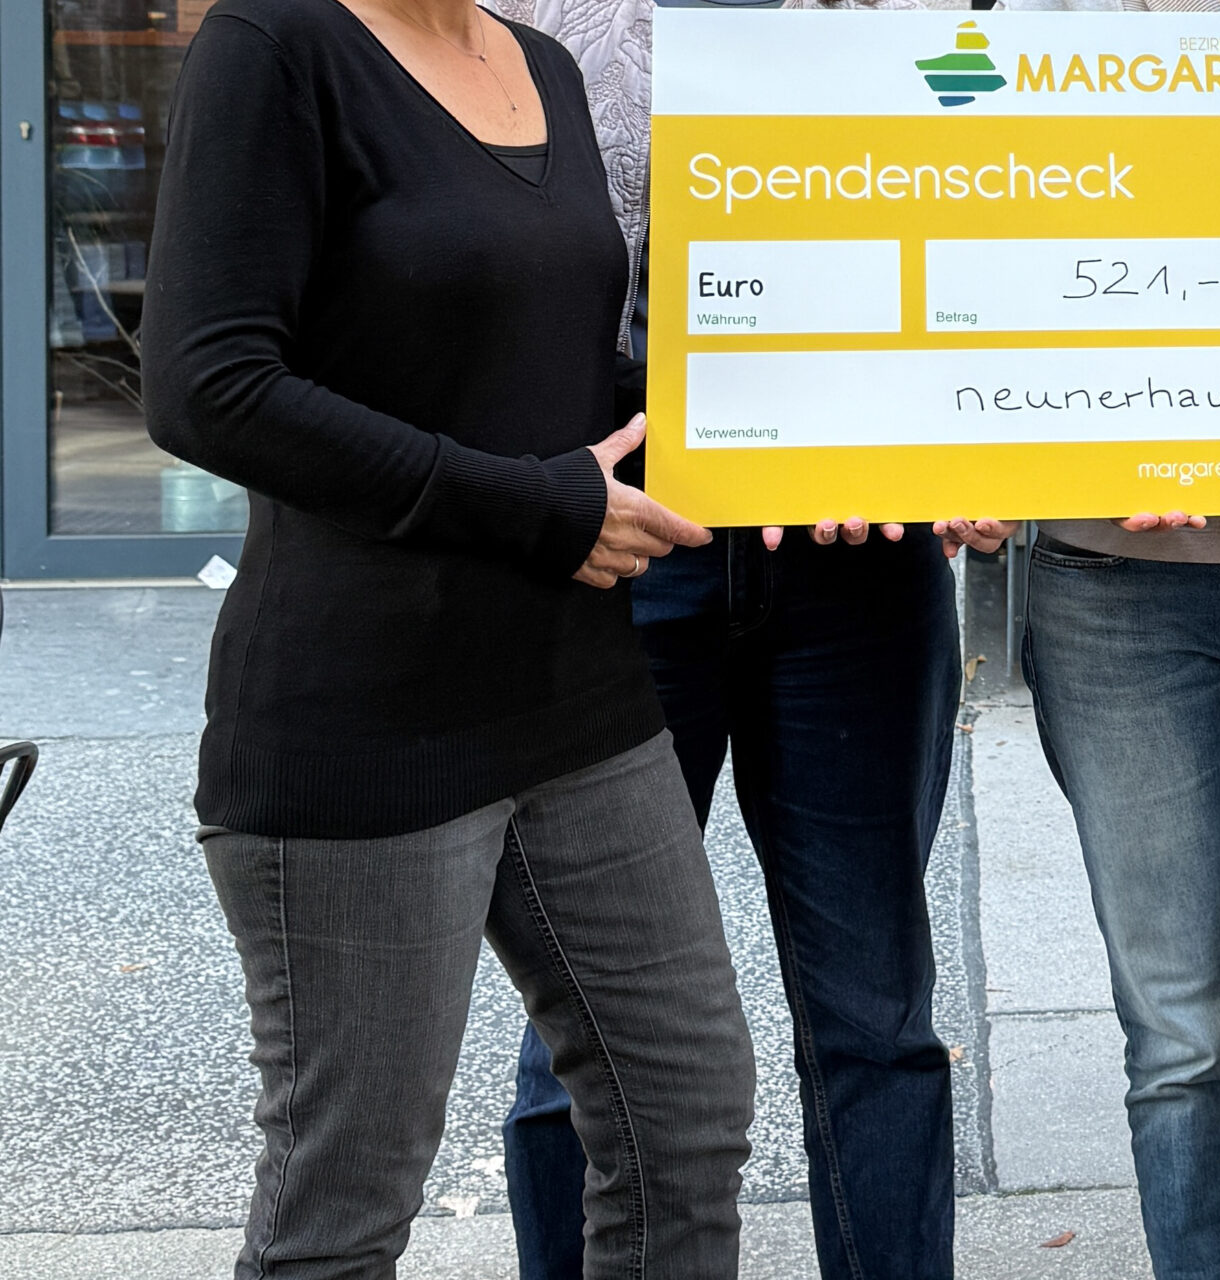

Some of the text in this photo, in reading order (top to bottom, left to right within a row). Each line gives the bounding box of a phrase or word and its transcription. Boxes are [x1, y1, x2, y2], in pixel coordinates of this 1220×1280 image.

[688, 152, 1135, 215] Spendenscheck
[699, 272, 764, 298] Euro
[696, 313, 757, 328] Währung
[936, 311, 978, 325] Betrag
[695, 427, 778, 440] Verwendung
